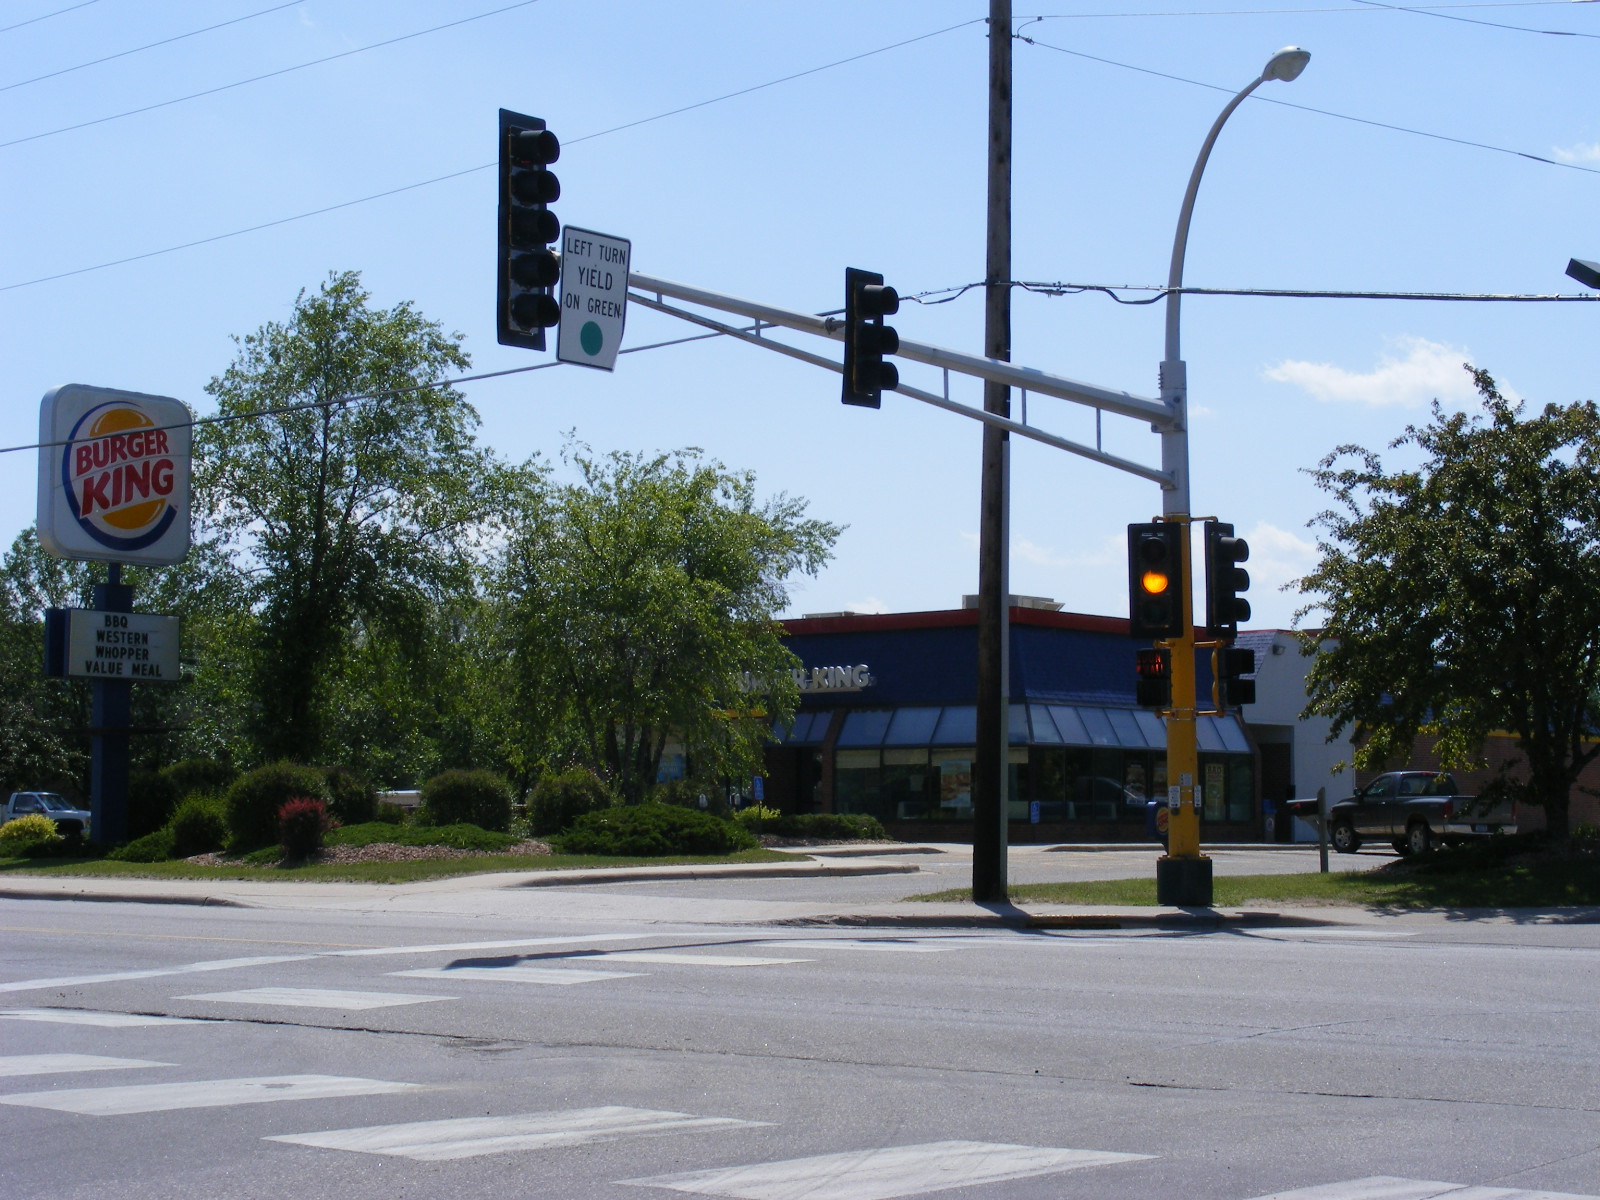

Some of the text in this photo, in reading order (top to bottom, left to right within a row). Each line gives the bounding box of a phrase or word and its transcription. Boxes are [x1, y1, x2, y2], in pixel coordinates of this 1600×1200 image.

[567, 237, 626, 266] LEFT TURN
[578, 265, 613, 291] YIELD
[565, 292, 621, 319] ON GREEN
[76, 430, 169, 477] BURGER
[79, 458, 174, 517] KING
[104, 614, 128, 628] BBQ
[96, 629, 149, 645] WESTERN
[95, 645, 149, 661] WHOPPER
[85, 660, 162, 677] VALUE MEAL
[812, 664, 869, 689] KING
